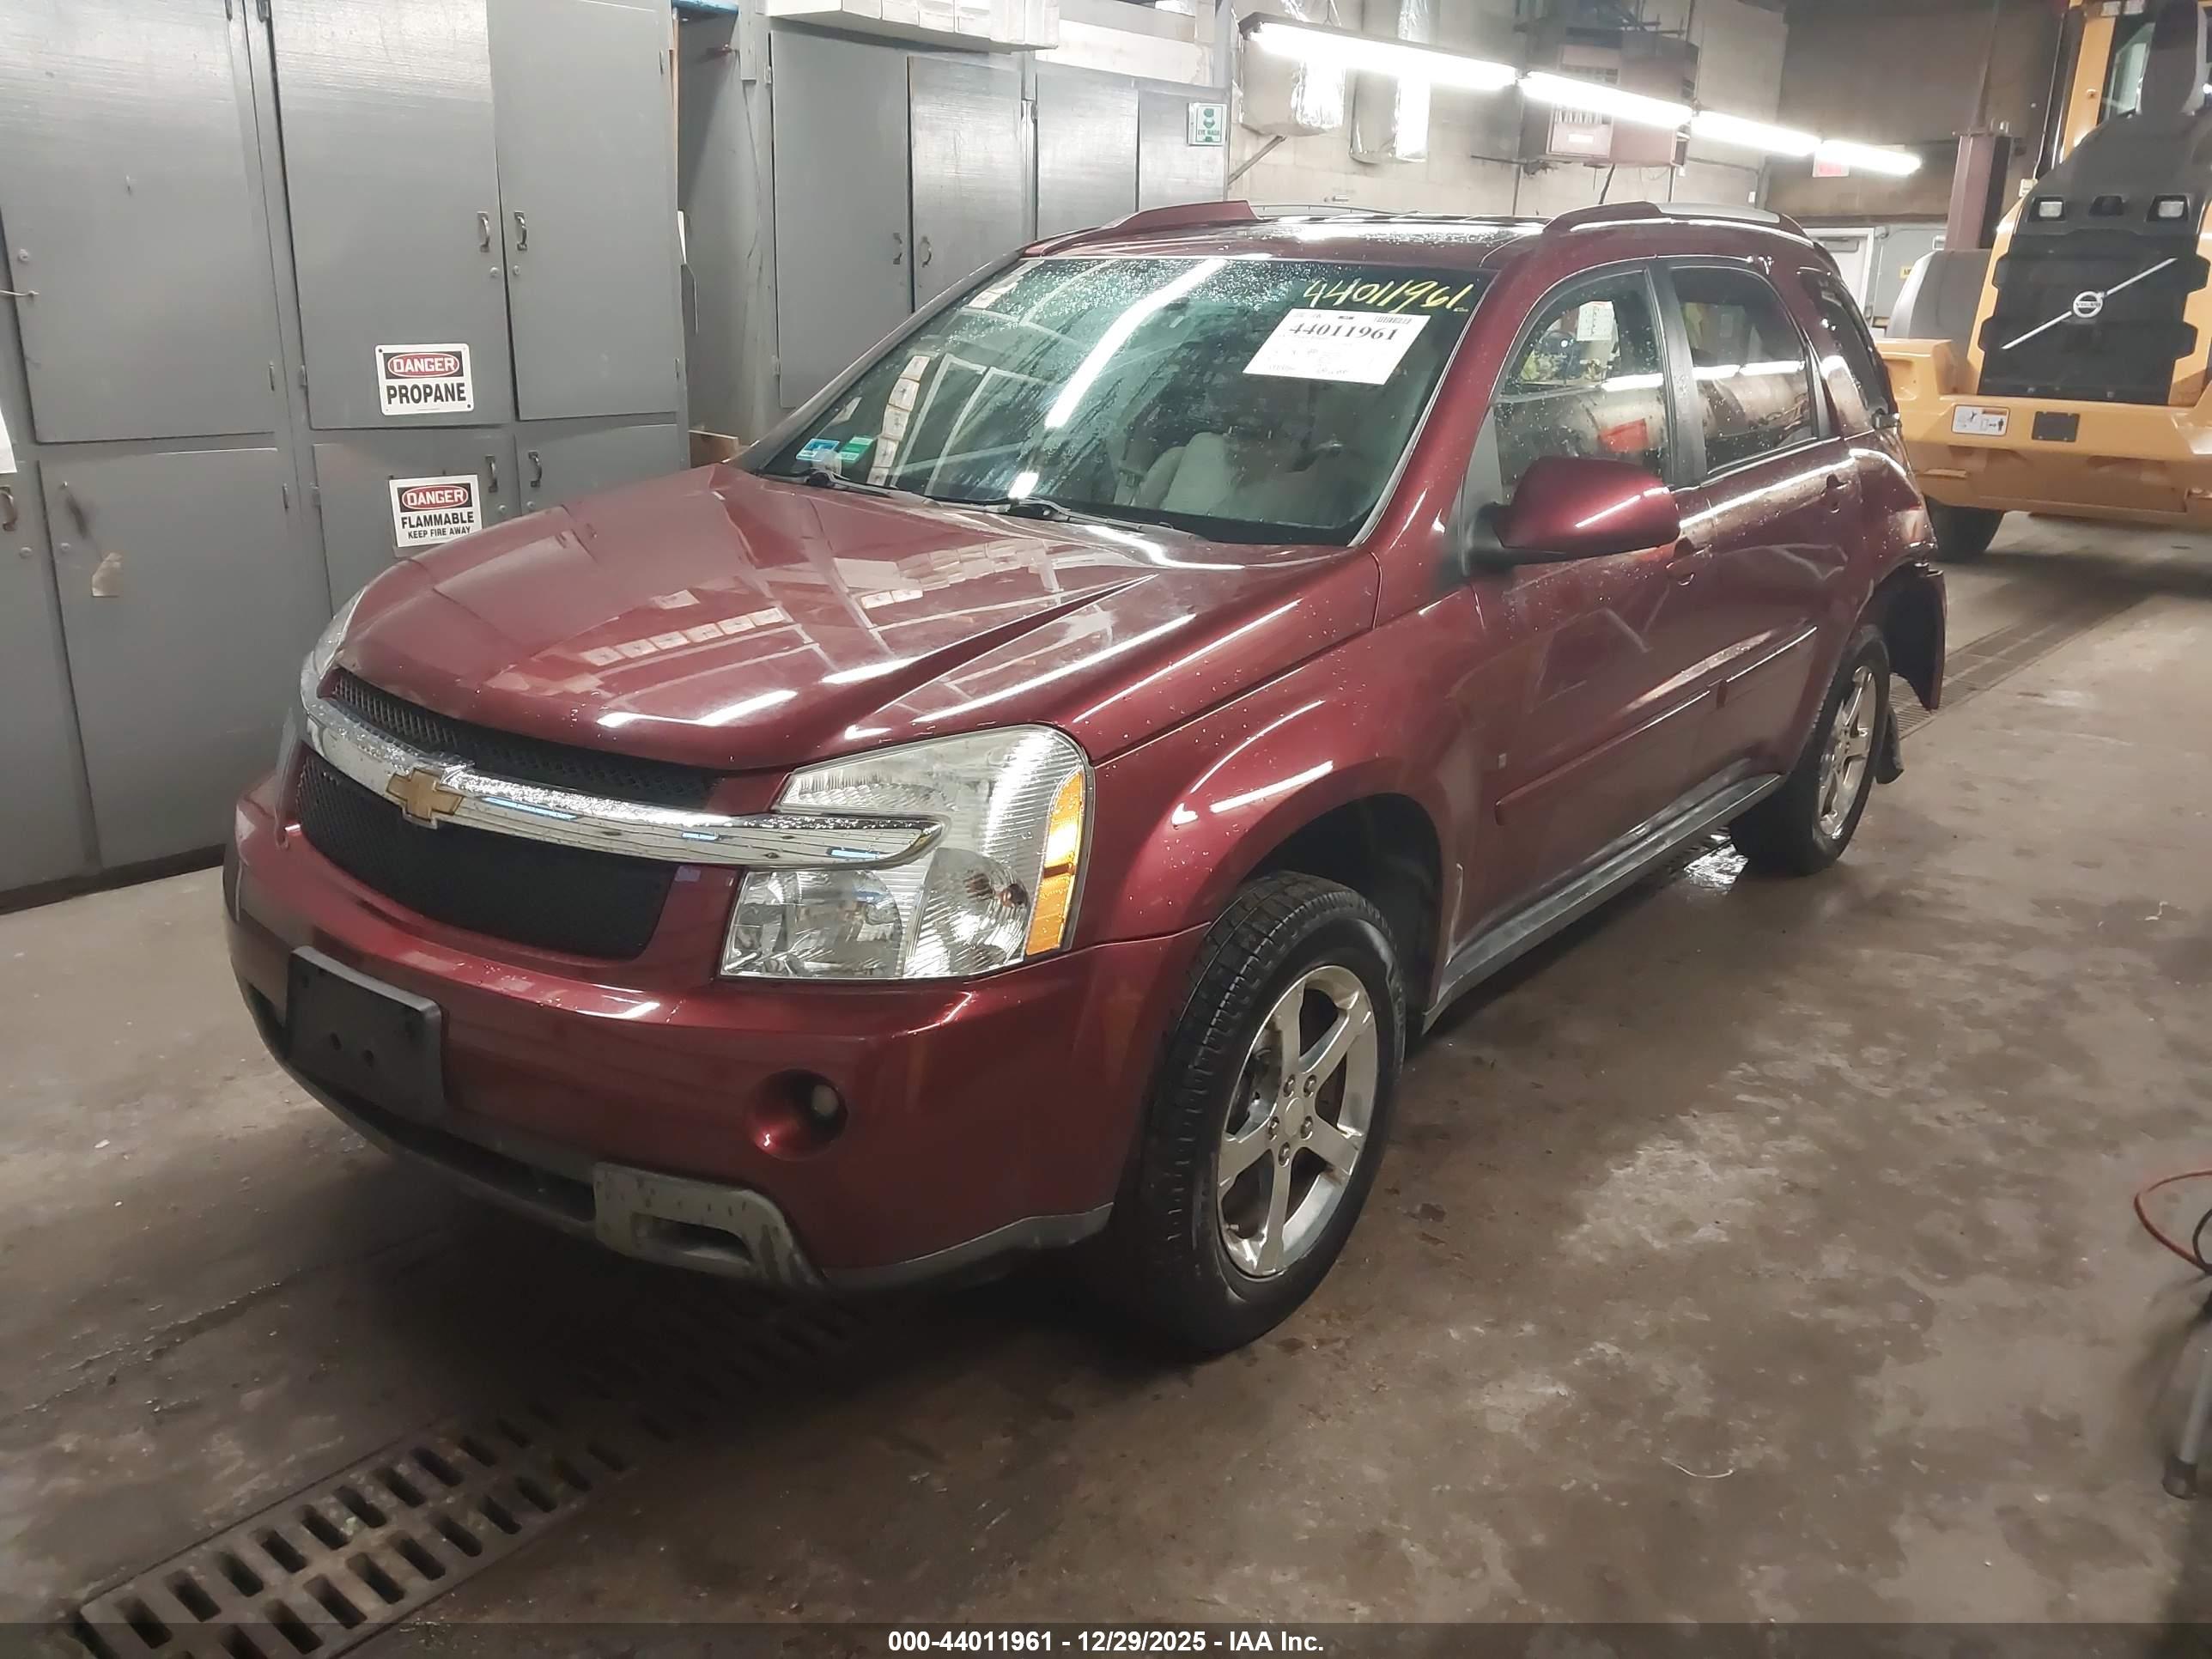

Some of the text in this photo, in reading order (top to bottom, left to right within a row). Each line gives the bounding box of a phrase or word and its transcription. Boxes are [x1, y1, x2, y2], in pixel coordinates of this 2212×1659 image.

[1303, 278, 1474, 314] 44011961
[1289, 322, 1399, 341] 44011961
[392, 357, 455, 373] DANGER
[386, 382, 466, 405] PROPANE
[406, 489, 465, 506] DANGER
[401, 511, 475, 529] FLAMMABLE
[408, 526, 471, 539] KEEP FIRE AWAY
